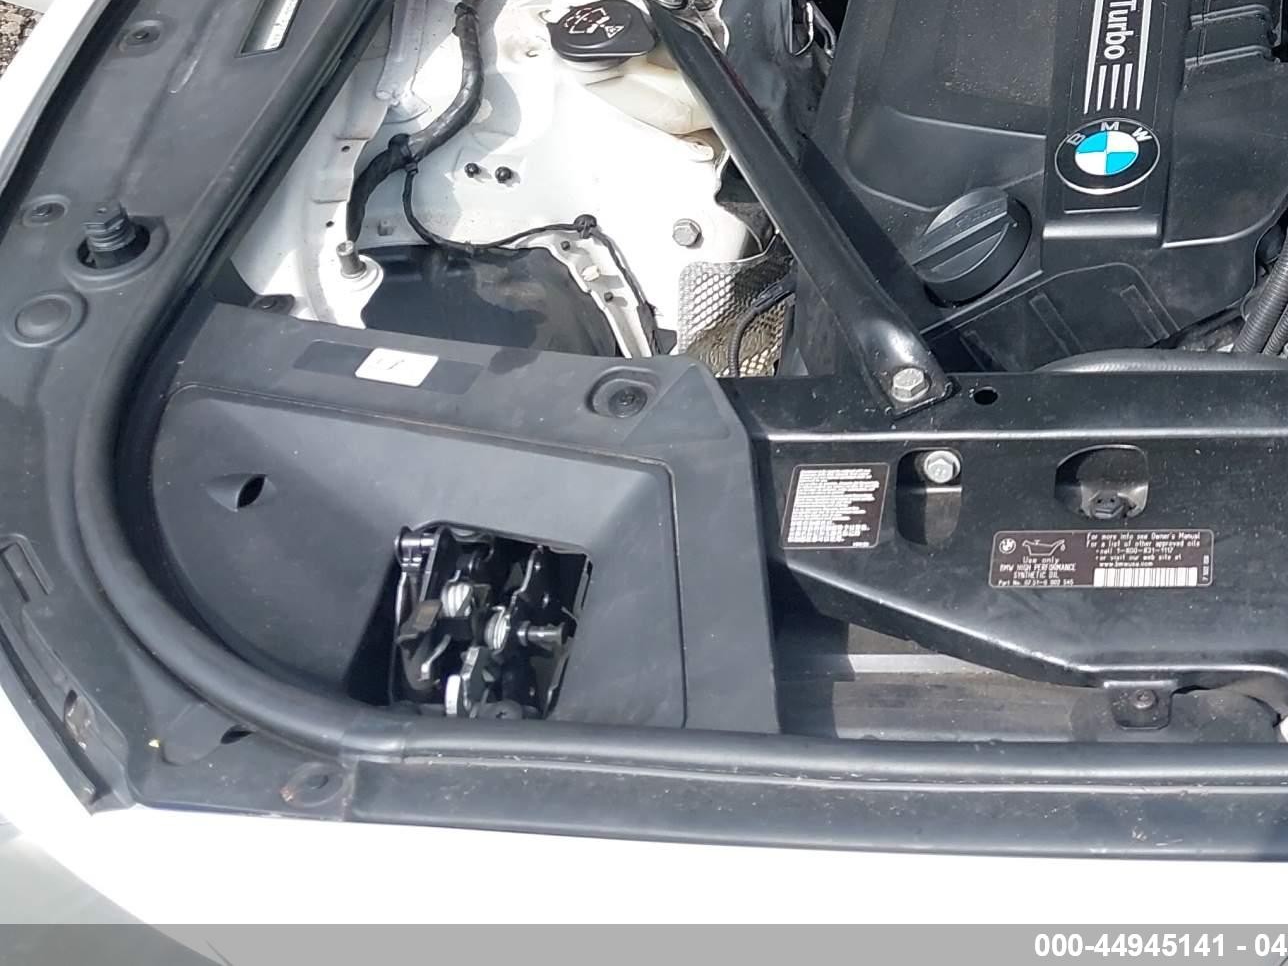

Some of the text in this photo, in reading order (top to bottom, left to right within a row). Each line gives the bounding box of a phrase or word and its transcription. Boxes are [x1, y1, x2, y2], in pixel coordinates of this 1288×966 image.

[1066, 121, 1153, 146] BMW
[1120, 532, 1134, 540] info
[1178, 531, 1200, 540] Manual
[1108, 539, 1120, 548] list
[1123, 539, 1132, 547] of
[1134, 539, 1152, 547] other
[1155, 539, 1184, 549] approved
[1022, 555, 1060, 565] Use only
[1034, 562, 1077, 571] PERFORMANCE
[1013, 571, 1046, 579] SYNTHETIC
